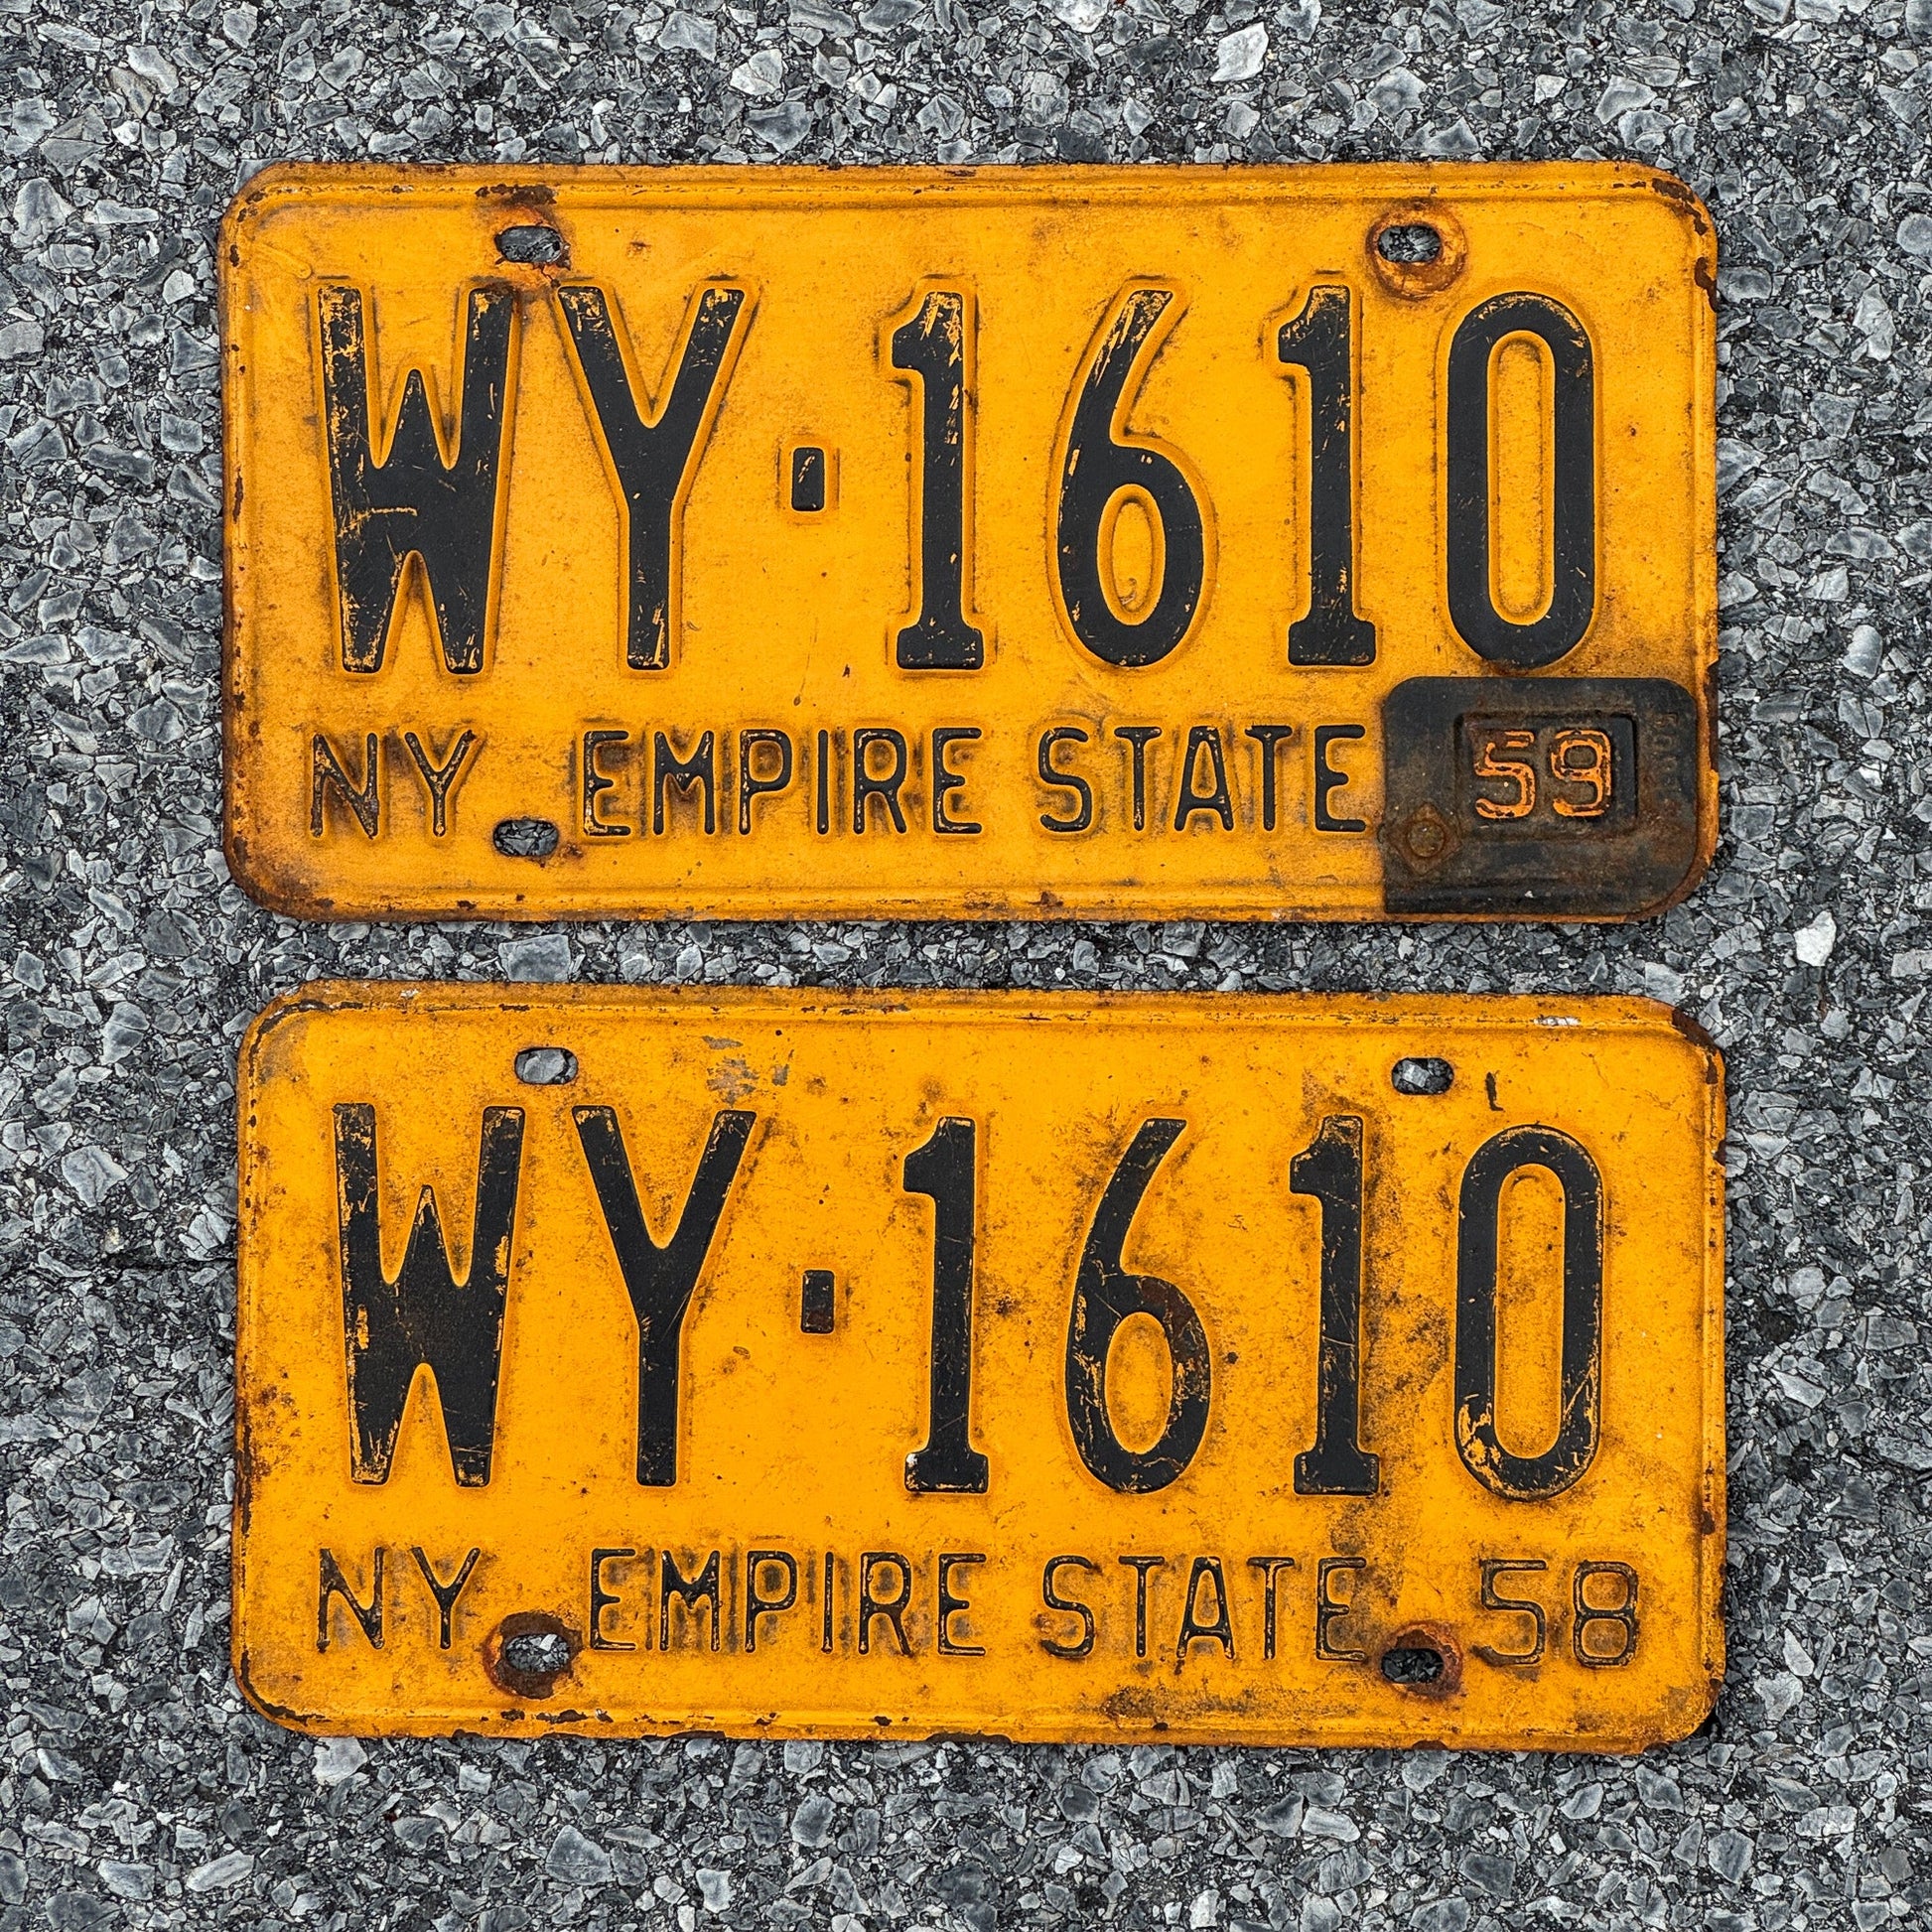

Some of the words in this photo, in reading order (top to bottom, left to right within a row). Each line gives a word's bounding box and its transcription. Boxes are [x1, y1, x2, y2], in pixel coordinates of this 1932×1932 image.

[310, 730, 477, 838] NY
[582, 727, 982, 837] EMPIRE
[1036, 724, 1367, 834] STATE
[1474, 729, 1612, 821] 59
[316, 1547, 482, 1652] NY
[589, 1547, 987, 1657] EMPIRE
[1040, 1554, 1368, 1661] STATE
[1478, 1559, 1640, 1668] 58
